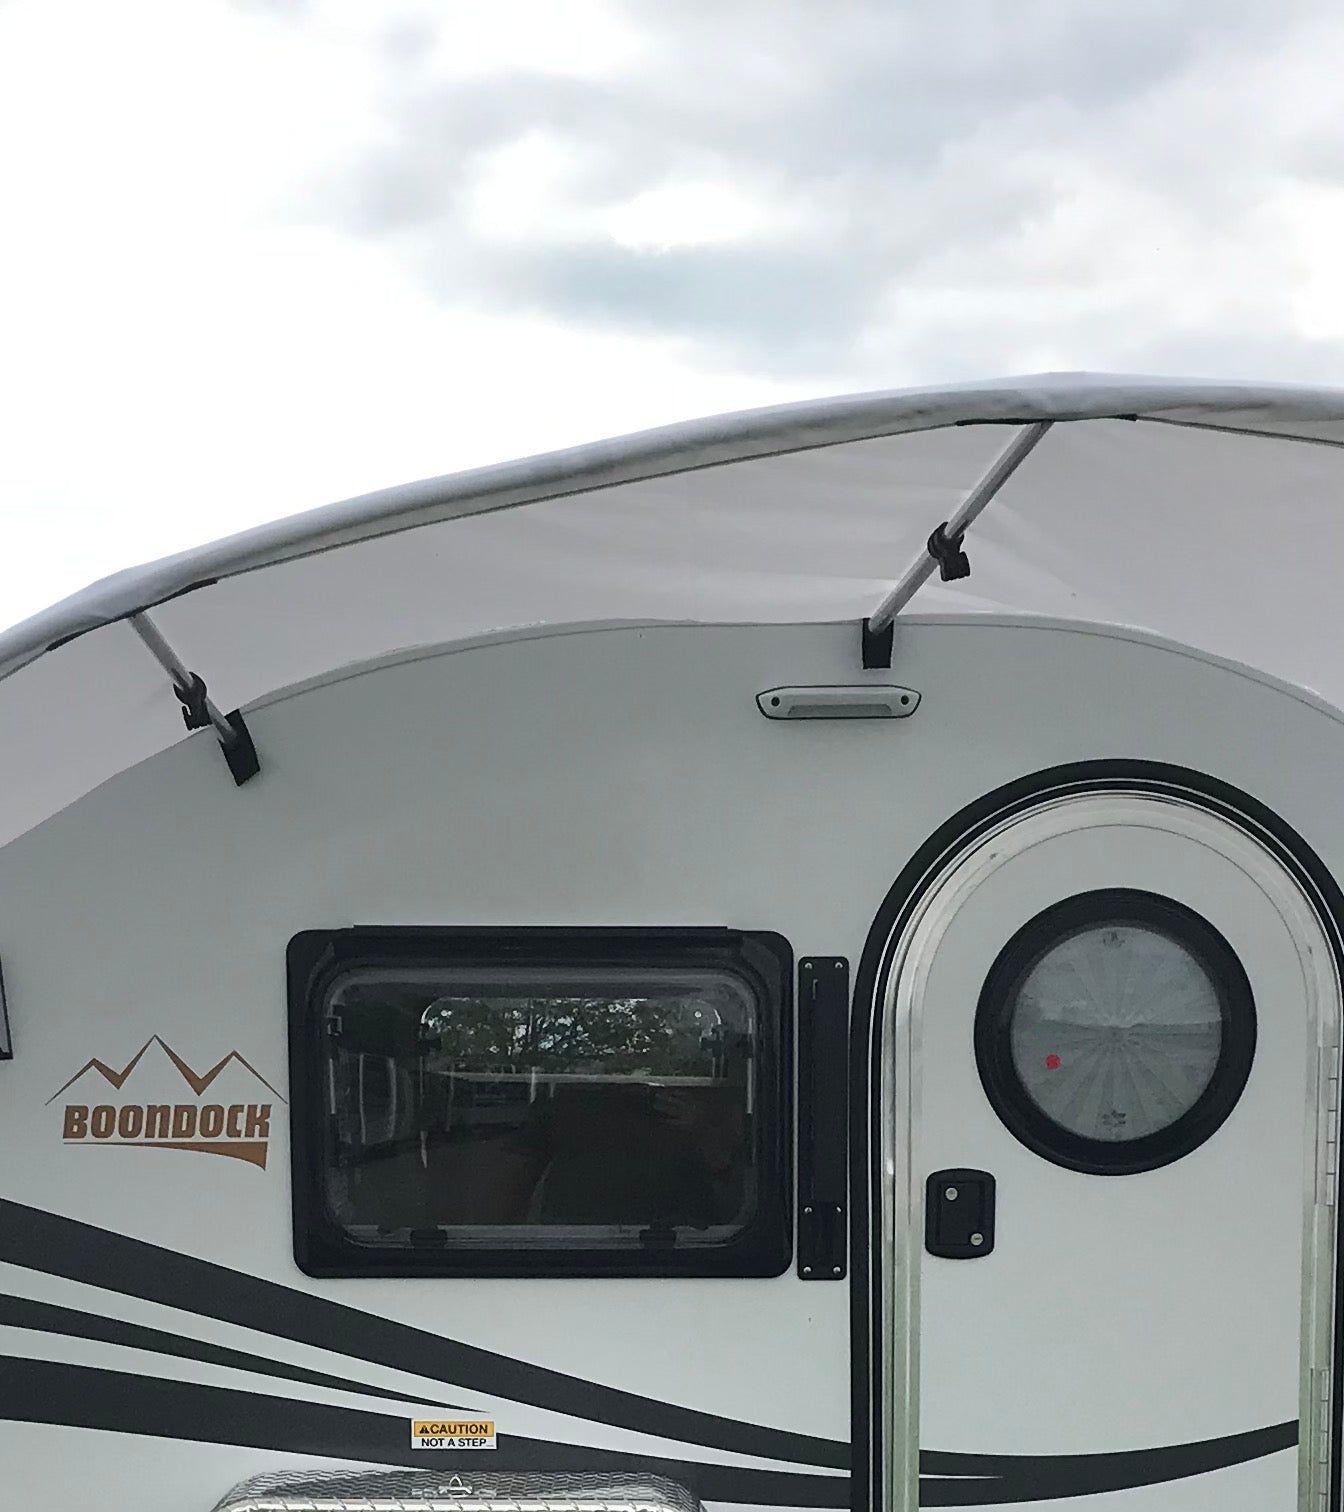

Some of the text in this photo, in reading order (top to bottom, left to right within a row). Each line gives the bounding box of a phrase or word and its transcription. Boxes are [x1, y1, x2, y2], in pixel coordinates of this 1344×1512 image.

[63, 1104, 272, 1139] BOONDOCK
[430, 1423, 488, 1435] CAUTION
[421, 1437, 487, 1447] NOT A STEP
